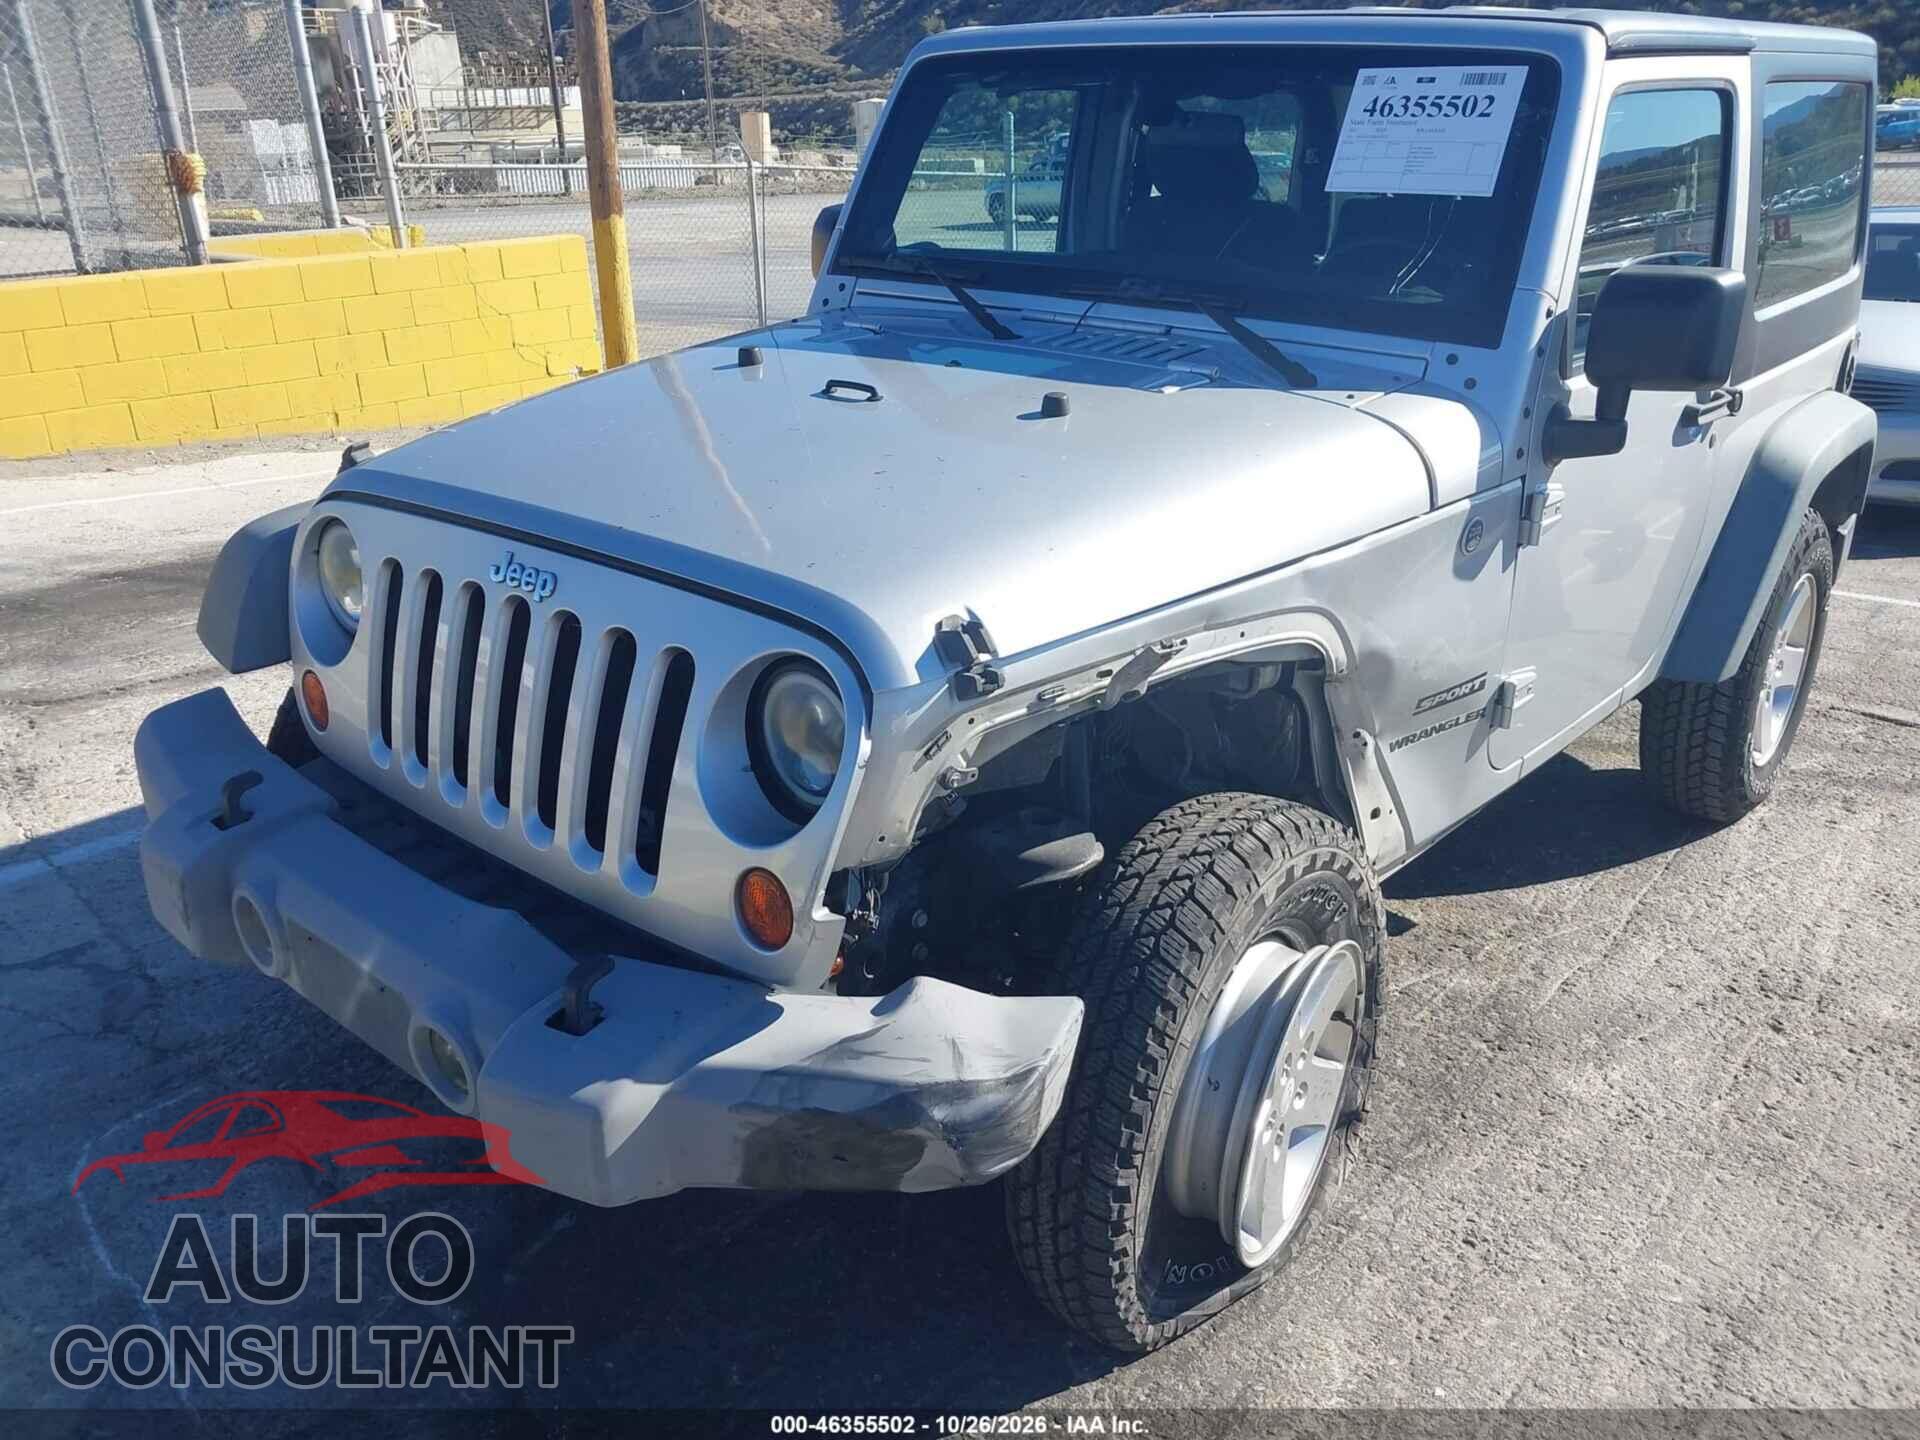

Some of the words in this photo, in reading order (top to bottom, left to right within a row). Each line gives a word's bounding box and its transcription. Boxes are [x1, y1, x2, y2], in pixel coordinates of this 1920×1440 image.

[1362, 94, 1496, 119] 46355502
[489, 550, 558, 603] Jeep
[1416, 677, 1486, 711] SPORT
[1389, 706, 1487, 753] WRANGLER
